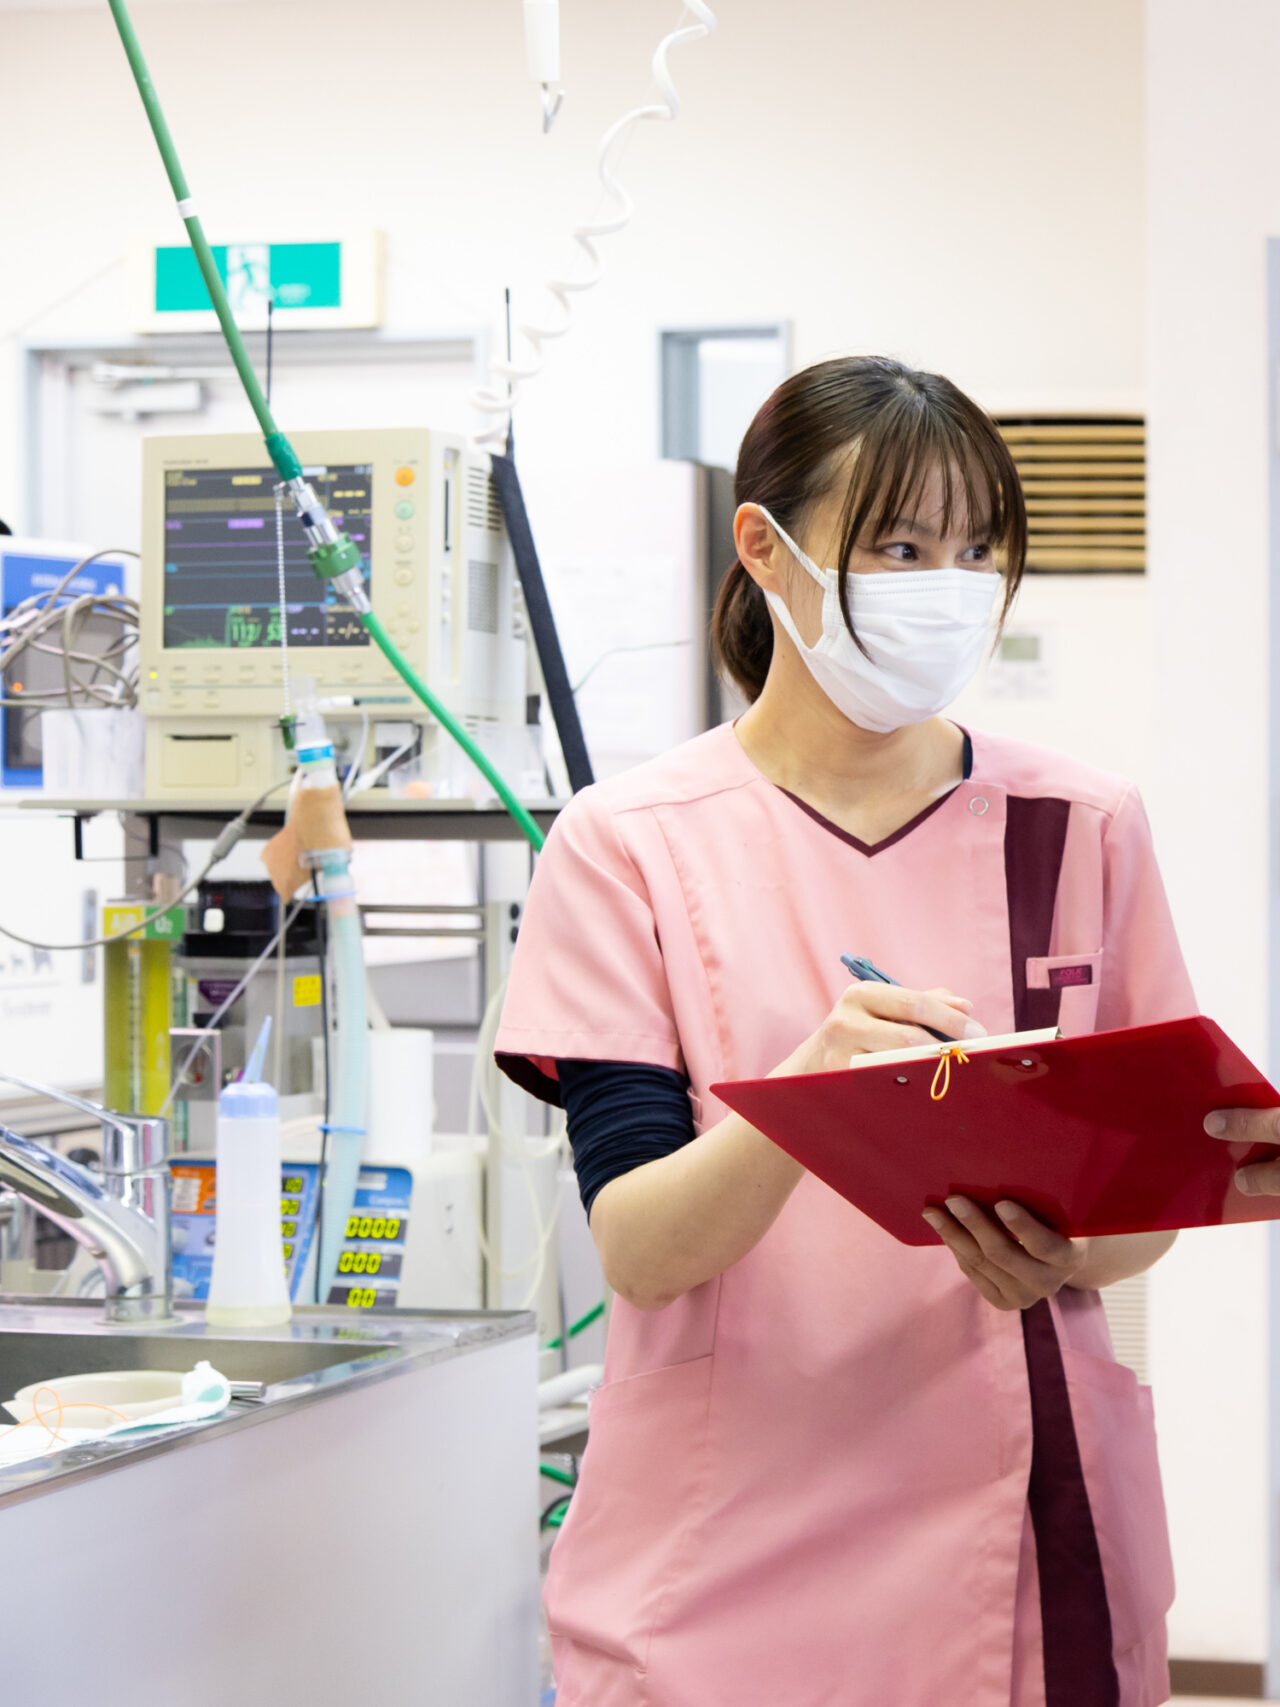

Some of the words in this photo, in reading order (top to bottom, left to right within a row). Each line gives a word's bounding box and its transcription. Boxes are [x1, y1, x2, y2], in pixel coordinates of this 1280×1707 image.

[345, 1216, 400, 1239] 0000
[338, 1251, 381, 1275] 000
[347, 1288, 376, 1308] 00
